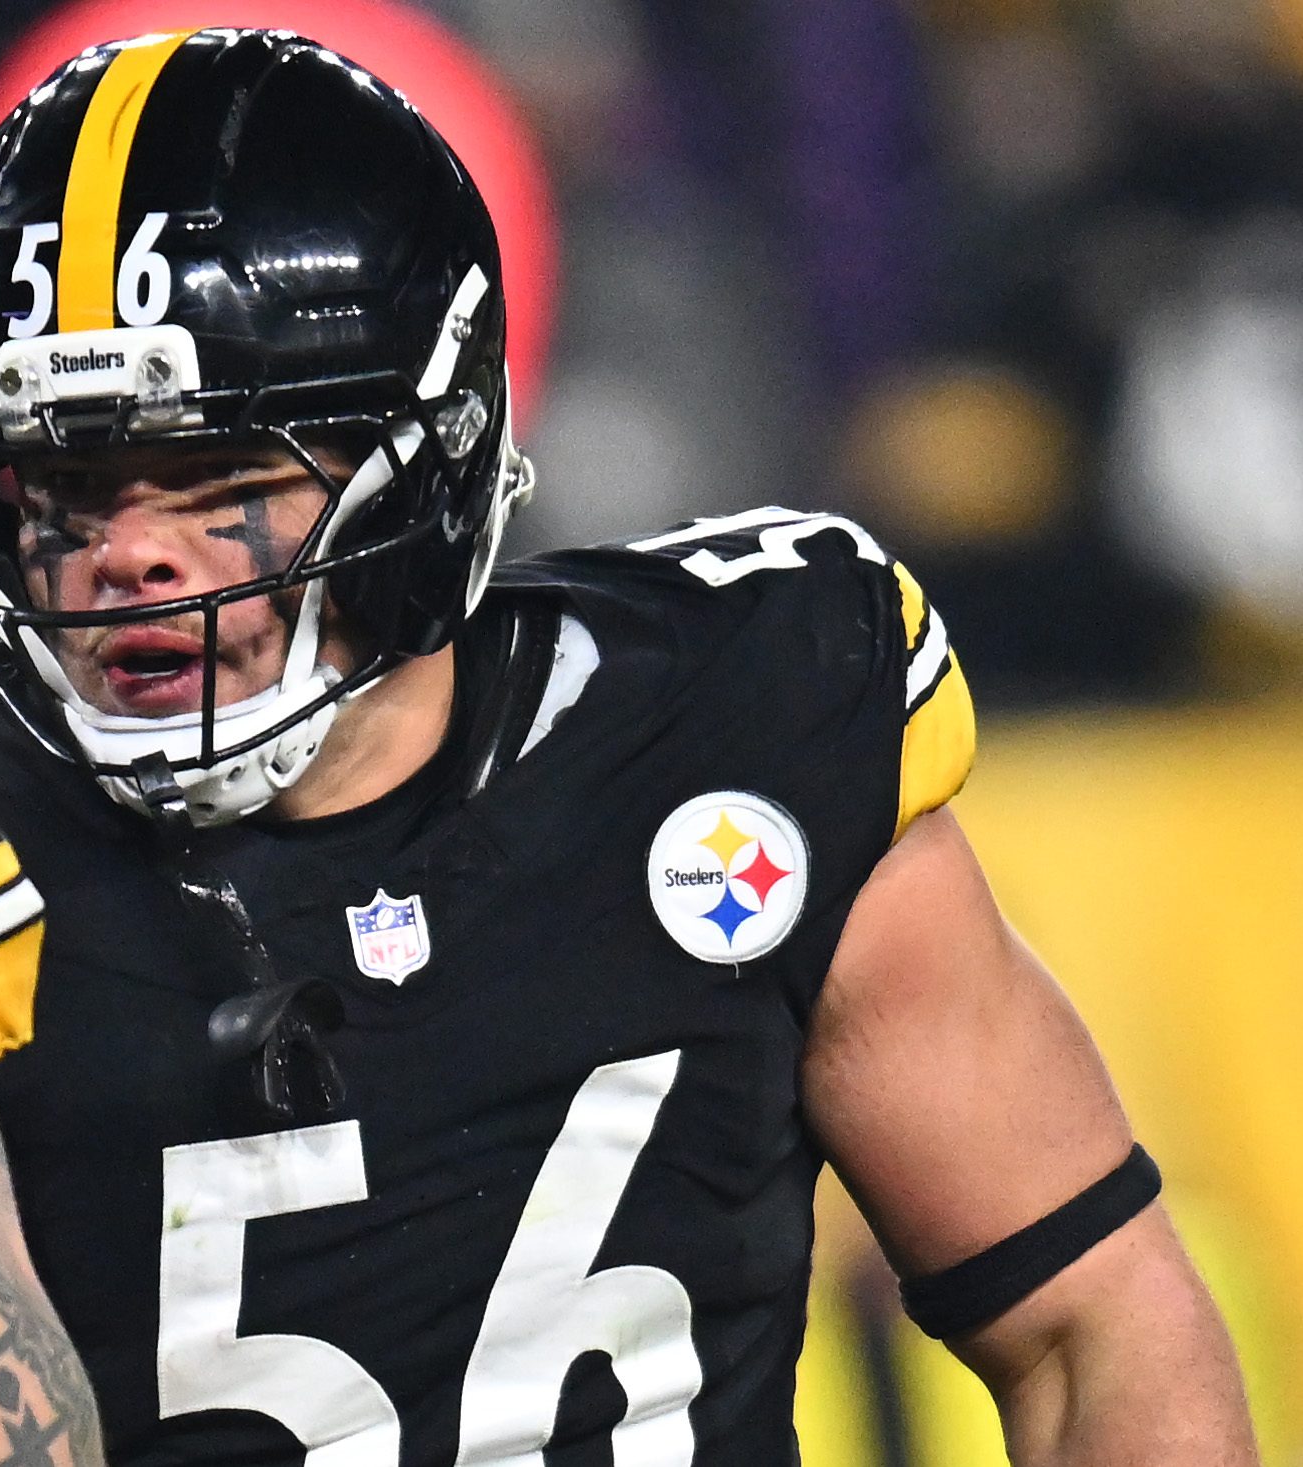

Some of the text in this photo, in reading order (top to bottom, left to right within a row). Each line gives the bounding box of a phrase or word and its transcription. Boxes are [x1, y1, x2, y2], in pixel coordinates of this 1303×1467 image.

[49, 347, 125, 375] Steelers
[664, 865, 724, 888] Steelers
[157, 1048, 703, 1467] 56
